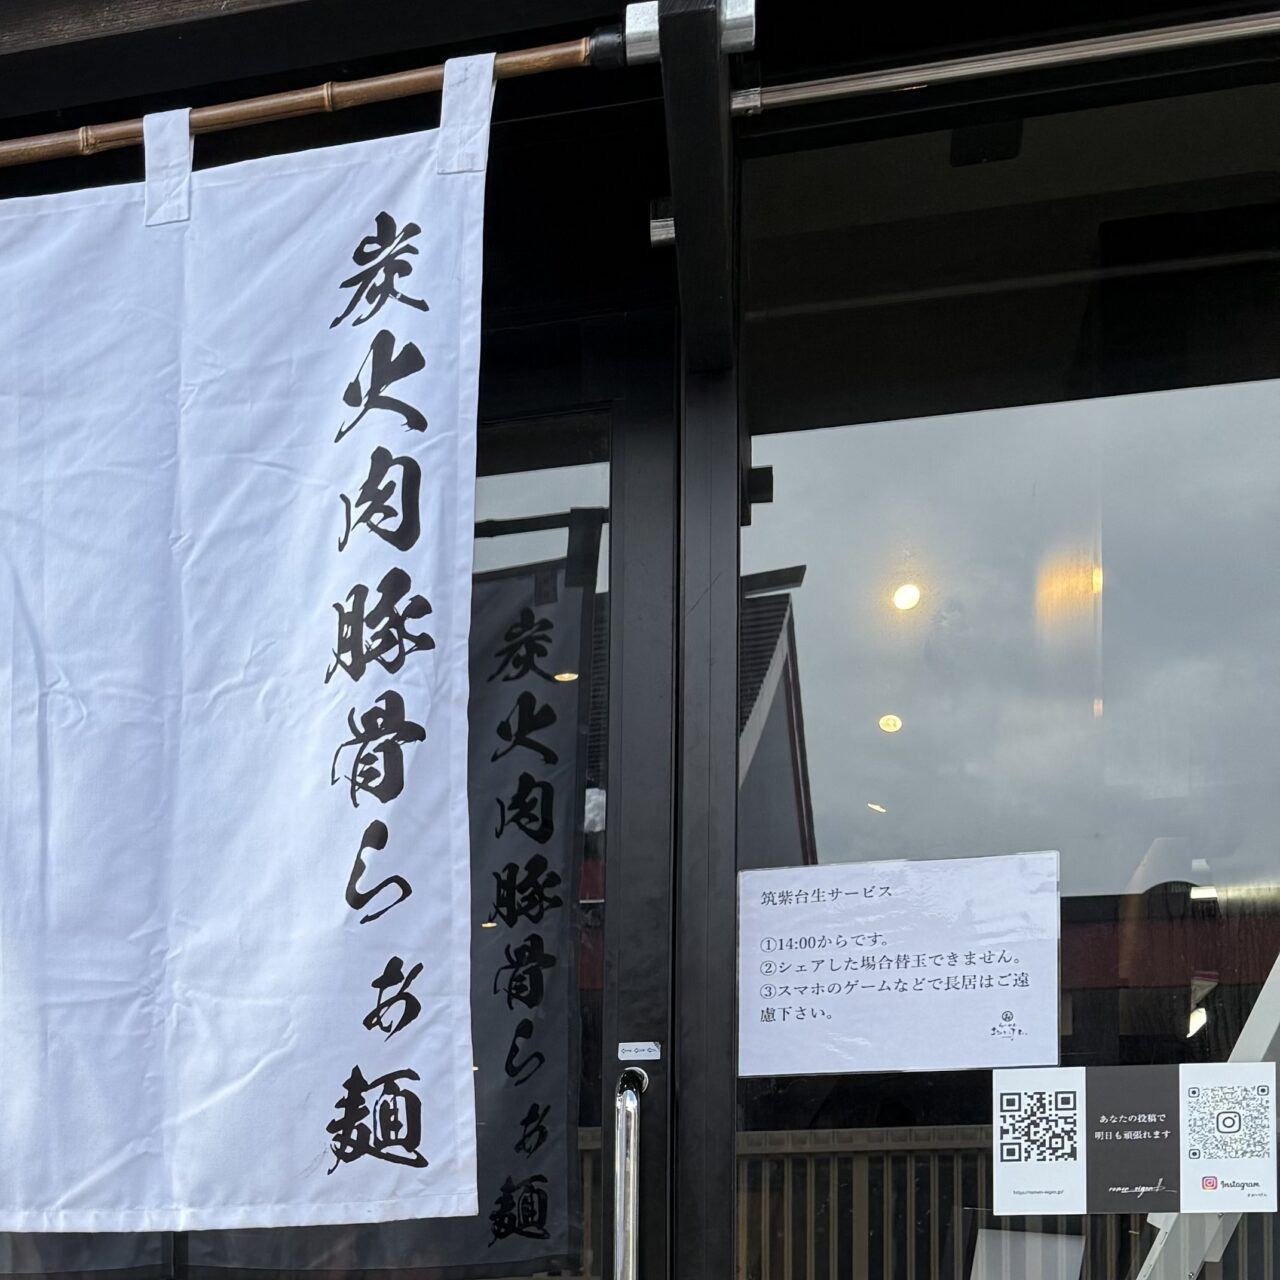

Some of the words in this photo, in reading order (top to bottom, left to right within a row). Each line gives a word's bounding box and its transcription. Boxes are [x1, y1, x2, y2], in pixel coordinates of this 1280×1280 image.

[760, 884, 893, 907] 筑紫台生サービス
[760, 1006, 833, 1023] 慮下さい。
[1099, 1113, 1167, 1124] あなたの投稿で
[1220, 1180, 1261, 1191] Instagram
